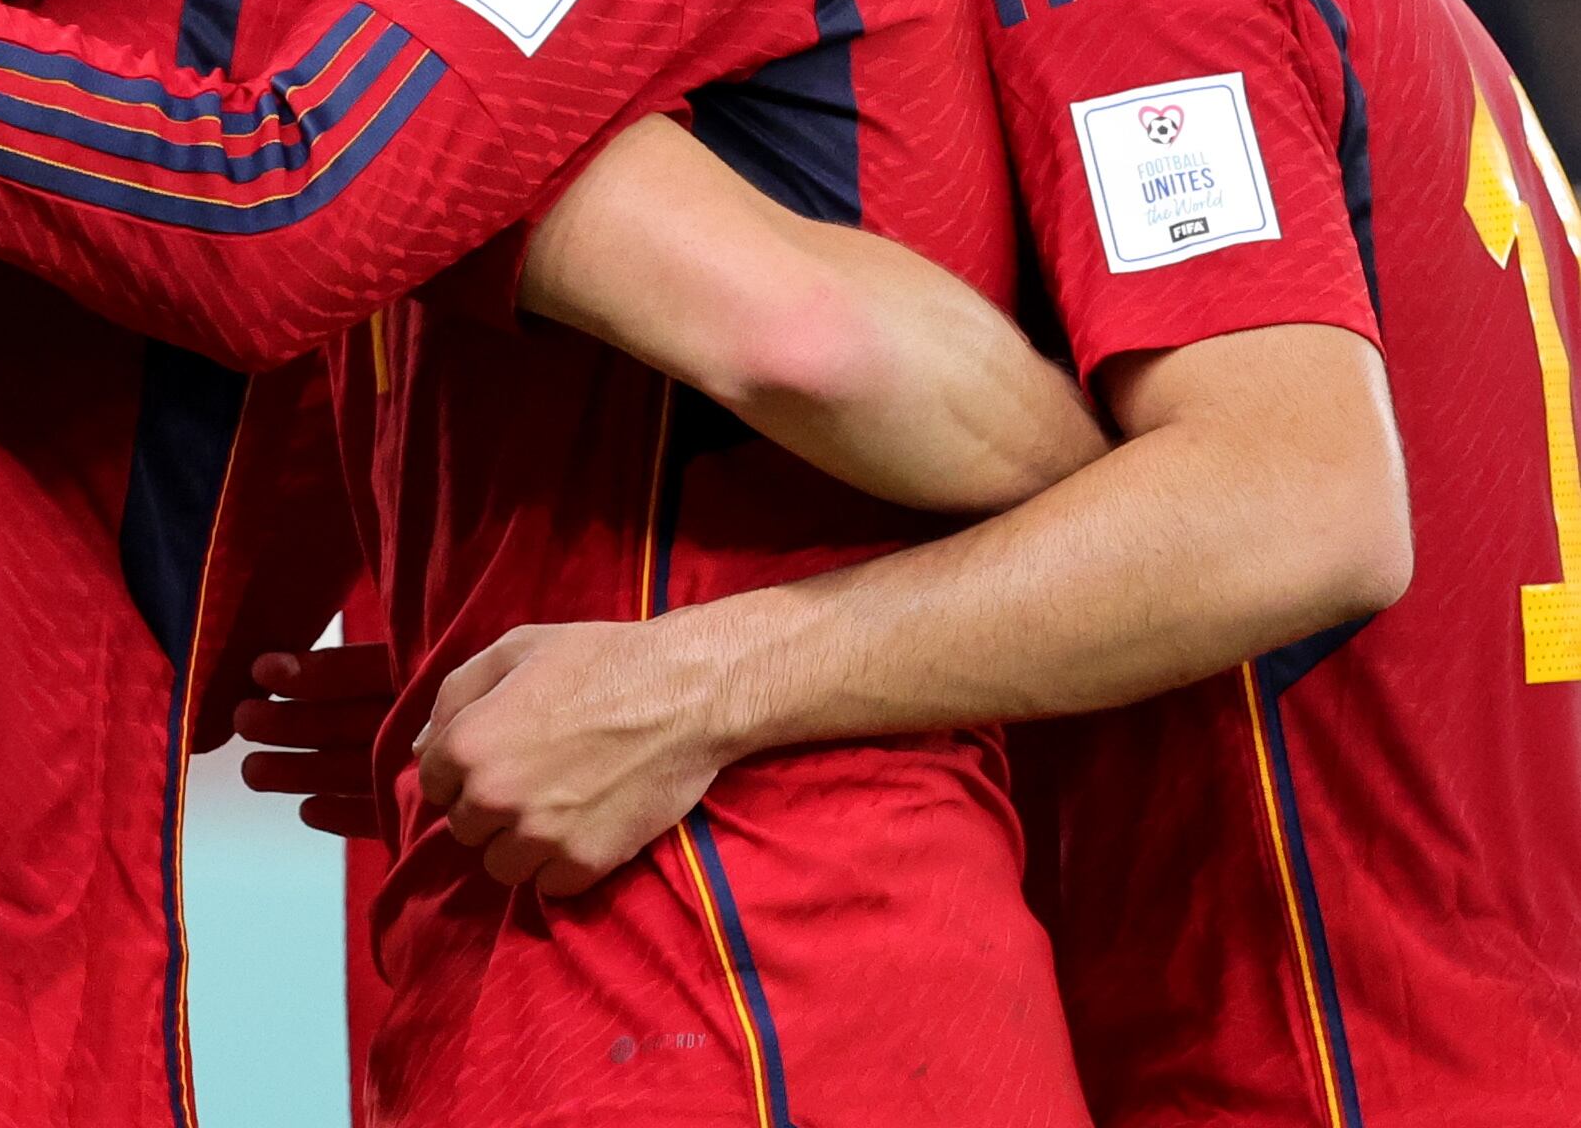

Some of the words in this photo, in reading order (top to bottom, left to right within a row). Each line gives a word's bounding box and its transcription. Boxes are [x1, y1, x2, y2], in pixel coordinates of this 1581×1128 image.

[1137, 152, 1210, 179] FOOTBALL
[1141, 168, 1216, 204] UNITES
[1146, 205, 1173, 226] the
[1174, 190, 1224, 217] World
[1171, 219, 1208, 241] FIFA
